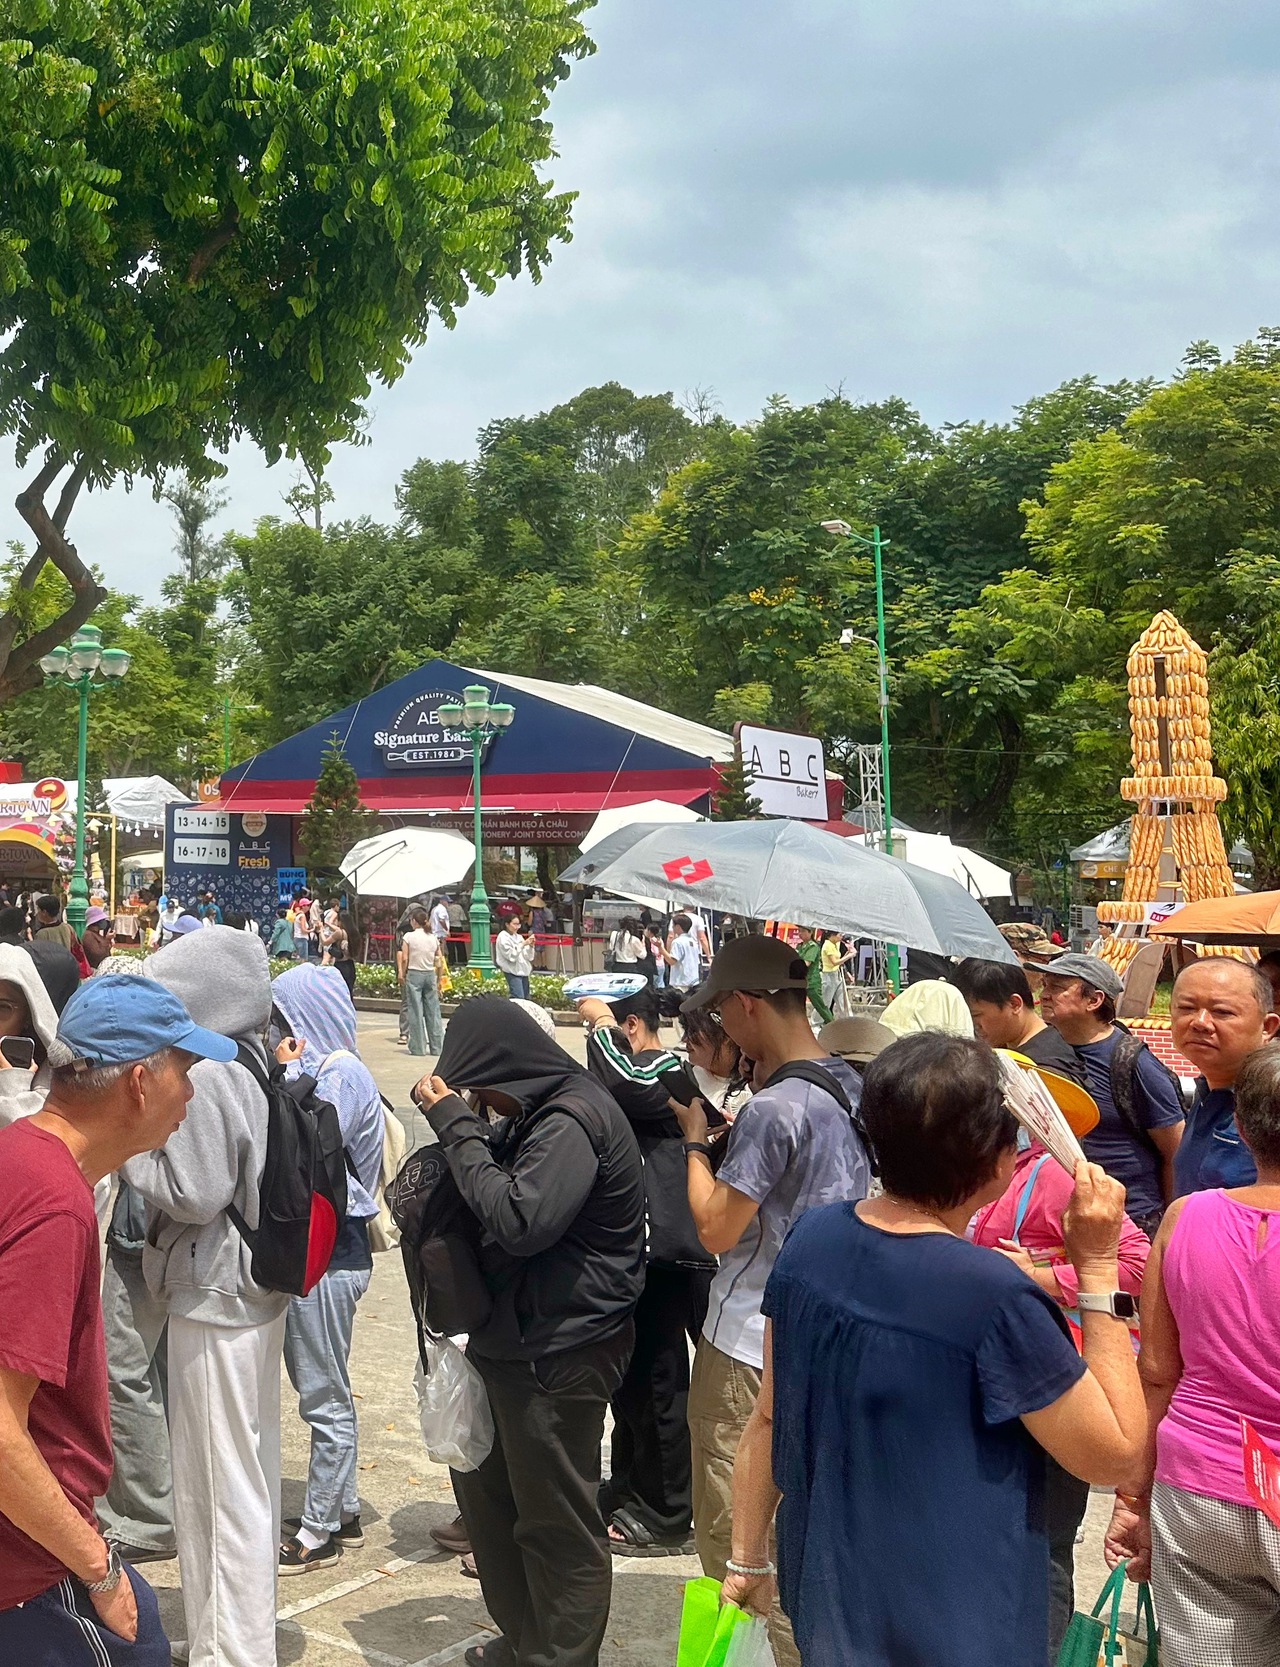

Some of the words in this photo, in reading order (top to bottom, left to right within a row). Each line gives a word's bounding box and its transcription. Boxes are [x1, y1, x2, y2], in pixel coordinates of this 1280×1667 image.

[394, 701, 414, 730] PREMIUM
[415, 692, 444, 704] QUALITY
[373, 731, 440, 749] Signature
[412, 751, 455, 760] EST.1984
[796, 786, 819, 799] Bakery
[178, 817, 188, 827] 13
[196, 817, 207, 827] 14
[215, 817, 227, 828] 15
[430, 820, 453, 829] CÔNG
[454, 821, 464, 829] TY
[499, 820, 521, 829] BÁNH
[521, 821, 537, 830] KẸO
[546, 819, 569, 829] CHÂU
[512, 831, 535, 839] JOINT
[536, 831, 562, 839] STOCK
[178, 846, 188, 857] 16
[196, 846, 207, 857] 17
[215, 847, 227, 858] 18
[238, 855, 270, 867] Fresh
